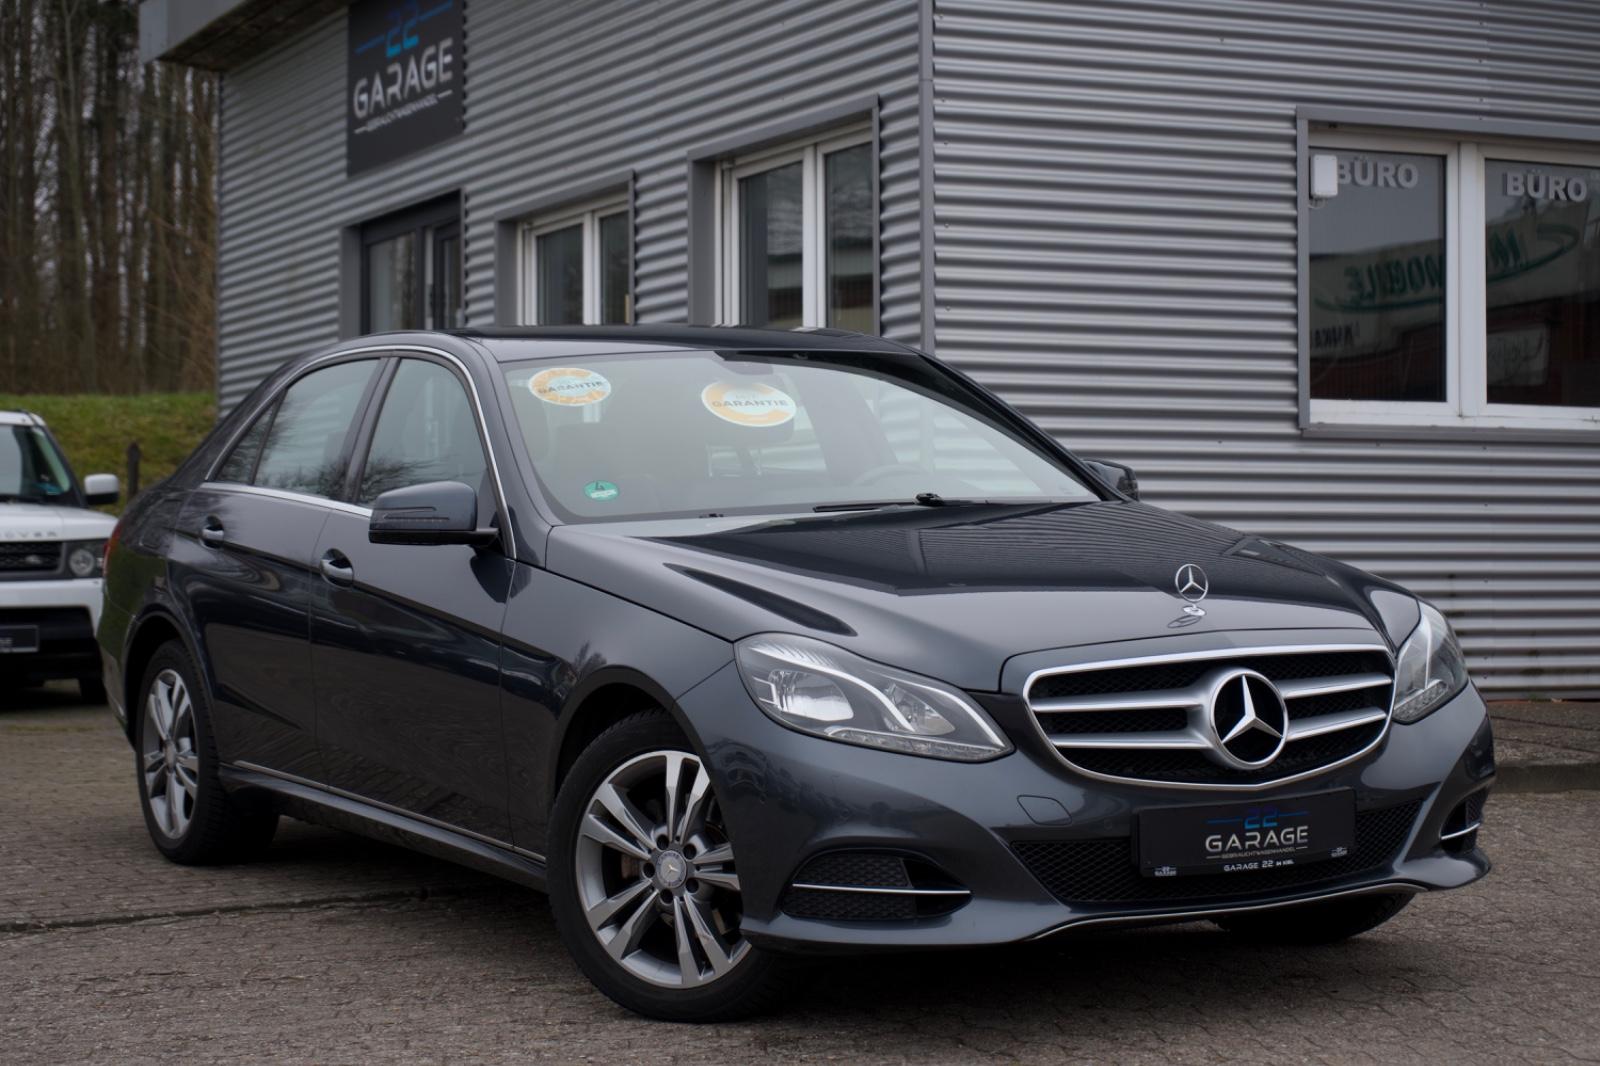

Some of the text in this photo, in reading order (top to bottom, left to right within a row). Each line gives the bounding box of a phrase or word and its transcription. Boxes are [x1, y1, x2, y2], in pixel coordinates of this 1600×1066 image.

[353, 37, 454, 119] GARAGE
[1505, 169, 1588, 203] BÜRO
[711, 399, 789, 409] GARANTIE
[1244, 805, 1279, 829] 22
[1205, 825, 1309, 853] GARAGE
[1223, 862, 1259, 872] GARAGE
[1262, 859, 1274, 868] 22
